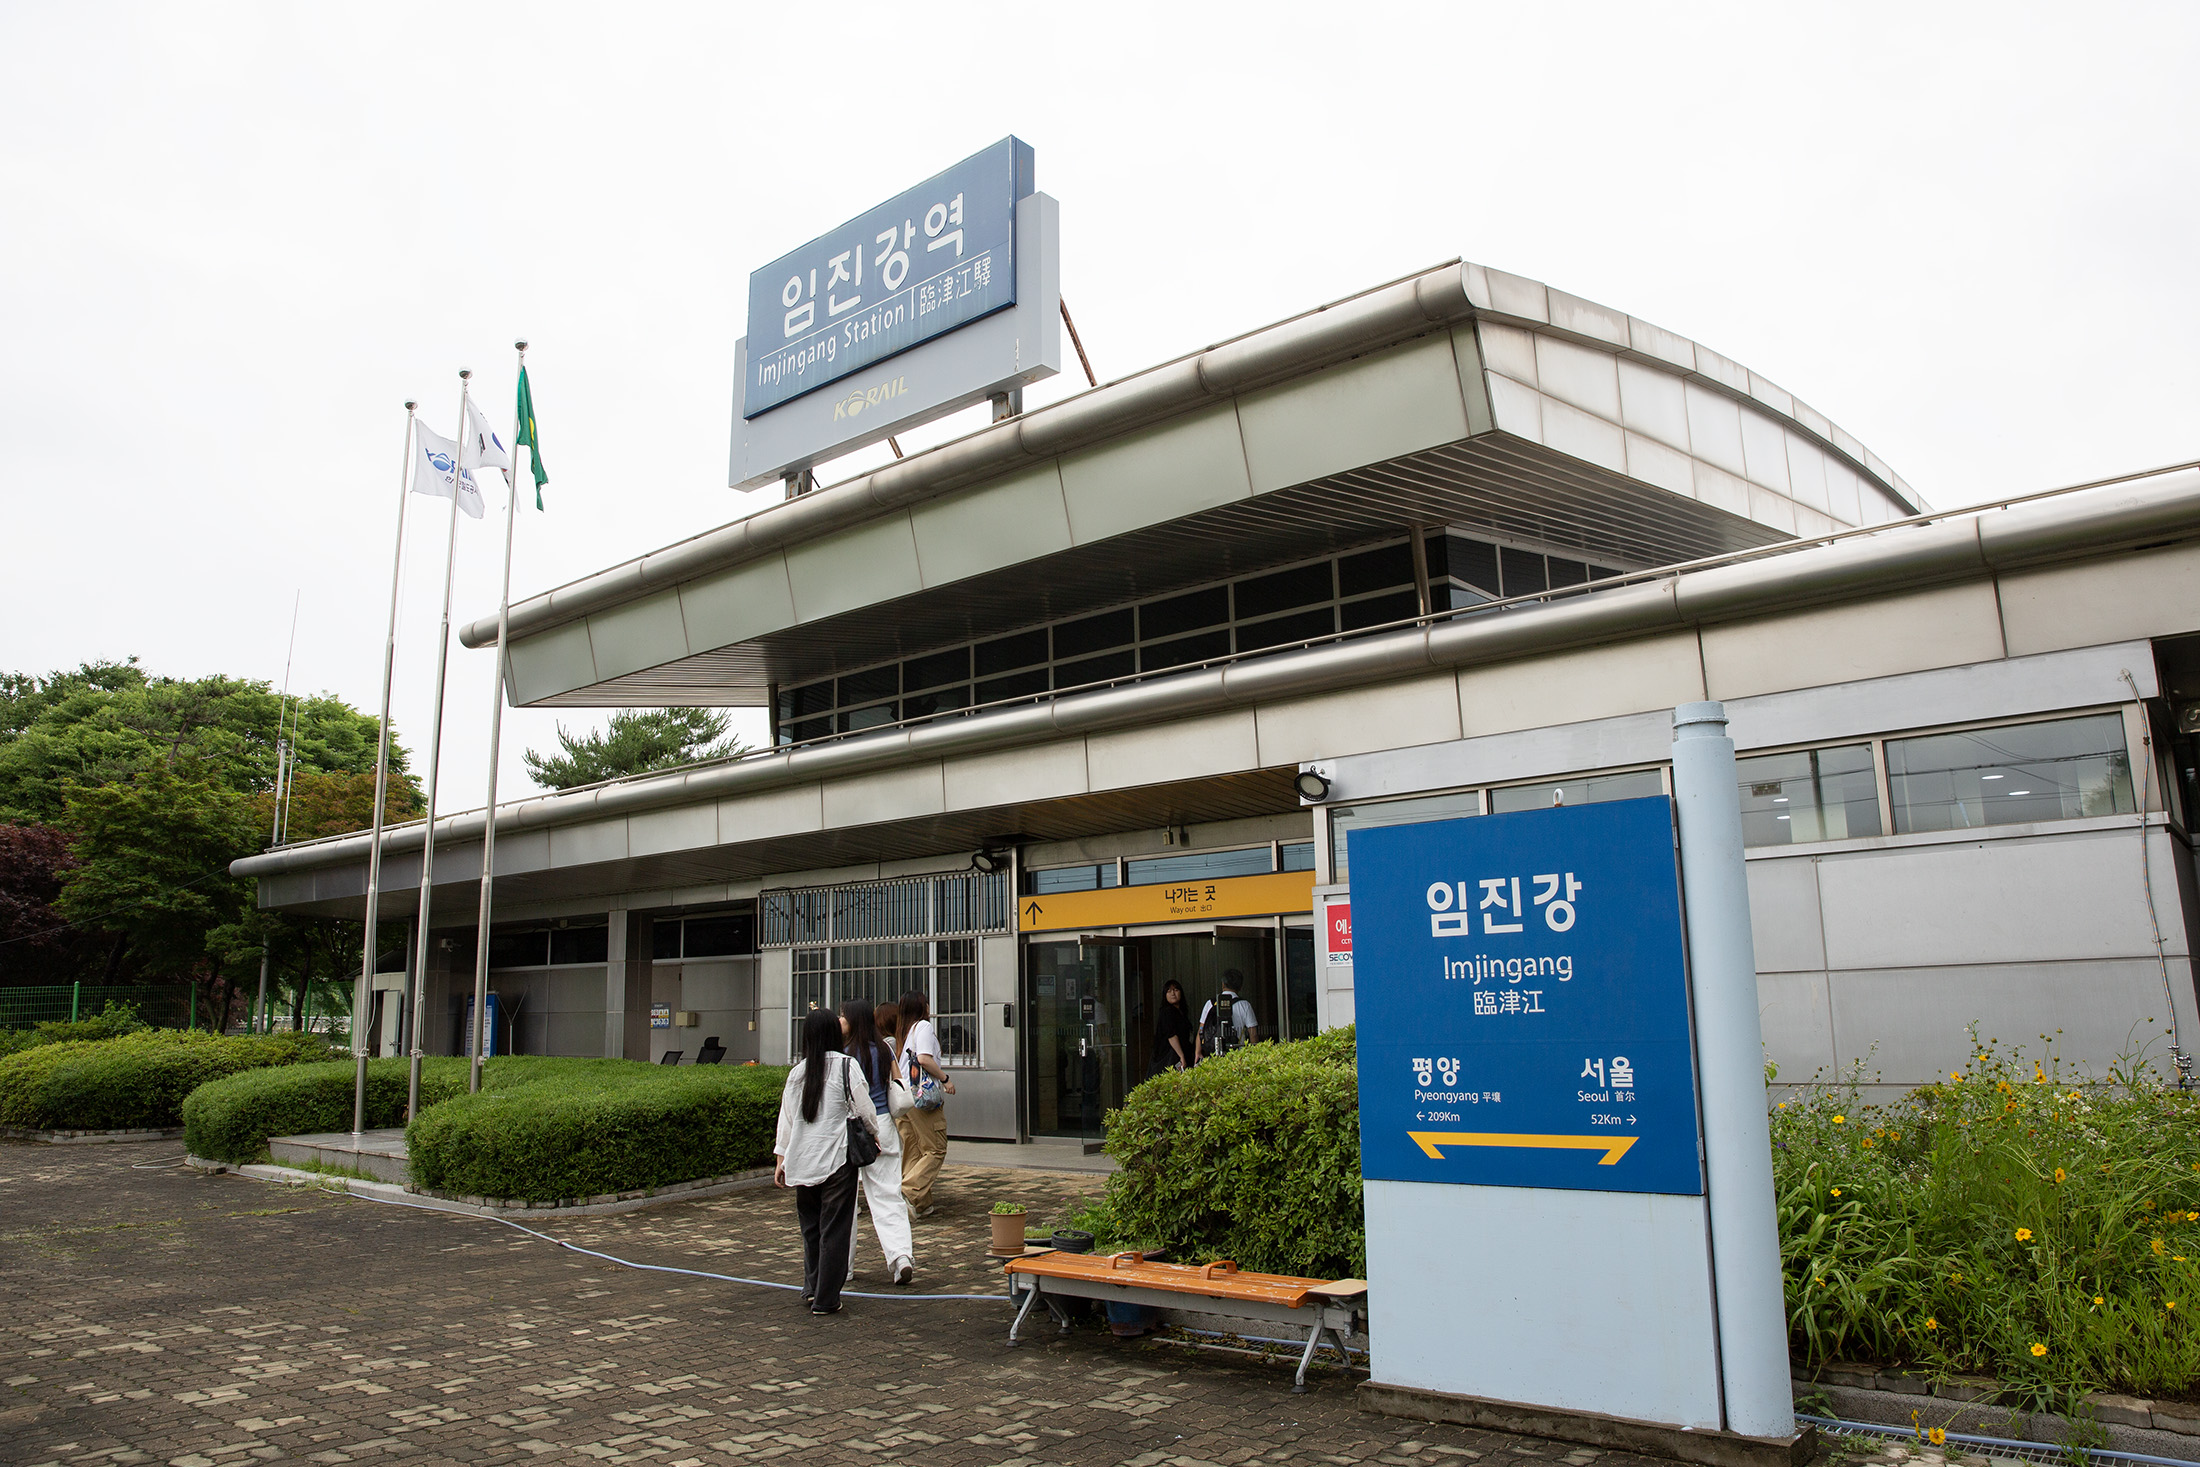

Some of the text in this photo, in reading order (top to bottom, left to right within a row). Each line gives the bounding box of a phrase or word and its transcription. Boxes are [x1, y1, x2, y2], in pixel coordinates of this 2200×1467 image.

[782, 192, 964, 339] 임진강역
[758, 303, 905, 387] Imjingang Station
[833, 375, 909, 422] KORAIL
[1165, 885, 1216, 904] 나가는 곳
[1426, 872, 1583, 938] 임진강
[1170, 905, 1197, 915] Way out
[1444, 954, 1573, 985] Imjingang
[1473, 989, 1546, 1016] 臨津江
[1412, 1057, 1461, 1087] 평양
[1580, 1056, 1634, 1088] 서울
[1414, 1089, 1479, 1104] Pyeongyang
[1577, 1090, 1610, 1102] Seoul
[1427, 1111, 1461, 1122] 209Km
[1591, 1114, 1622, 1125] 52Km
